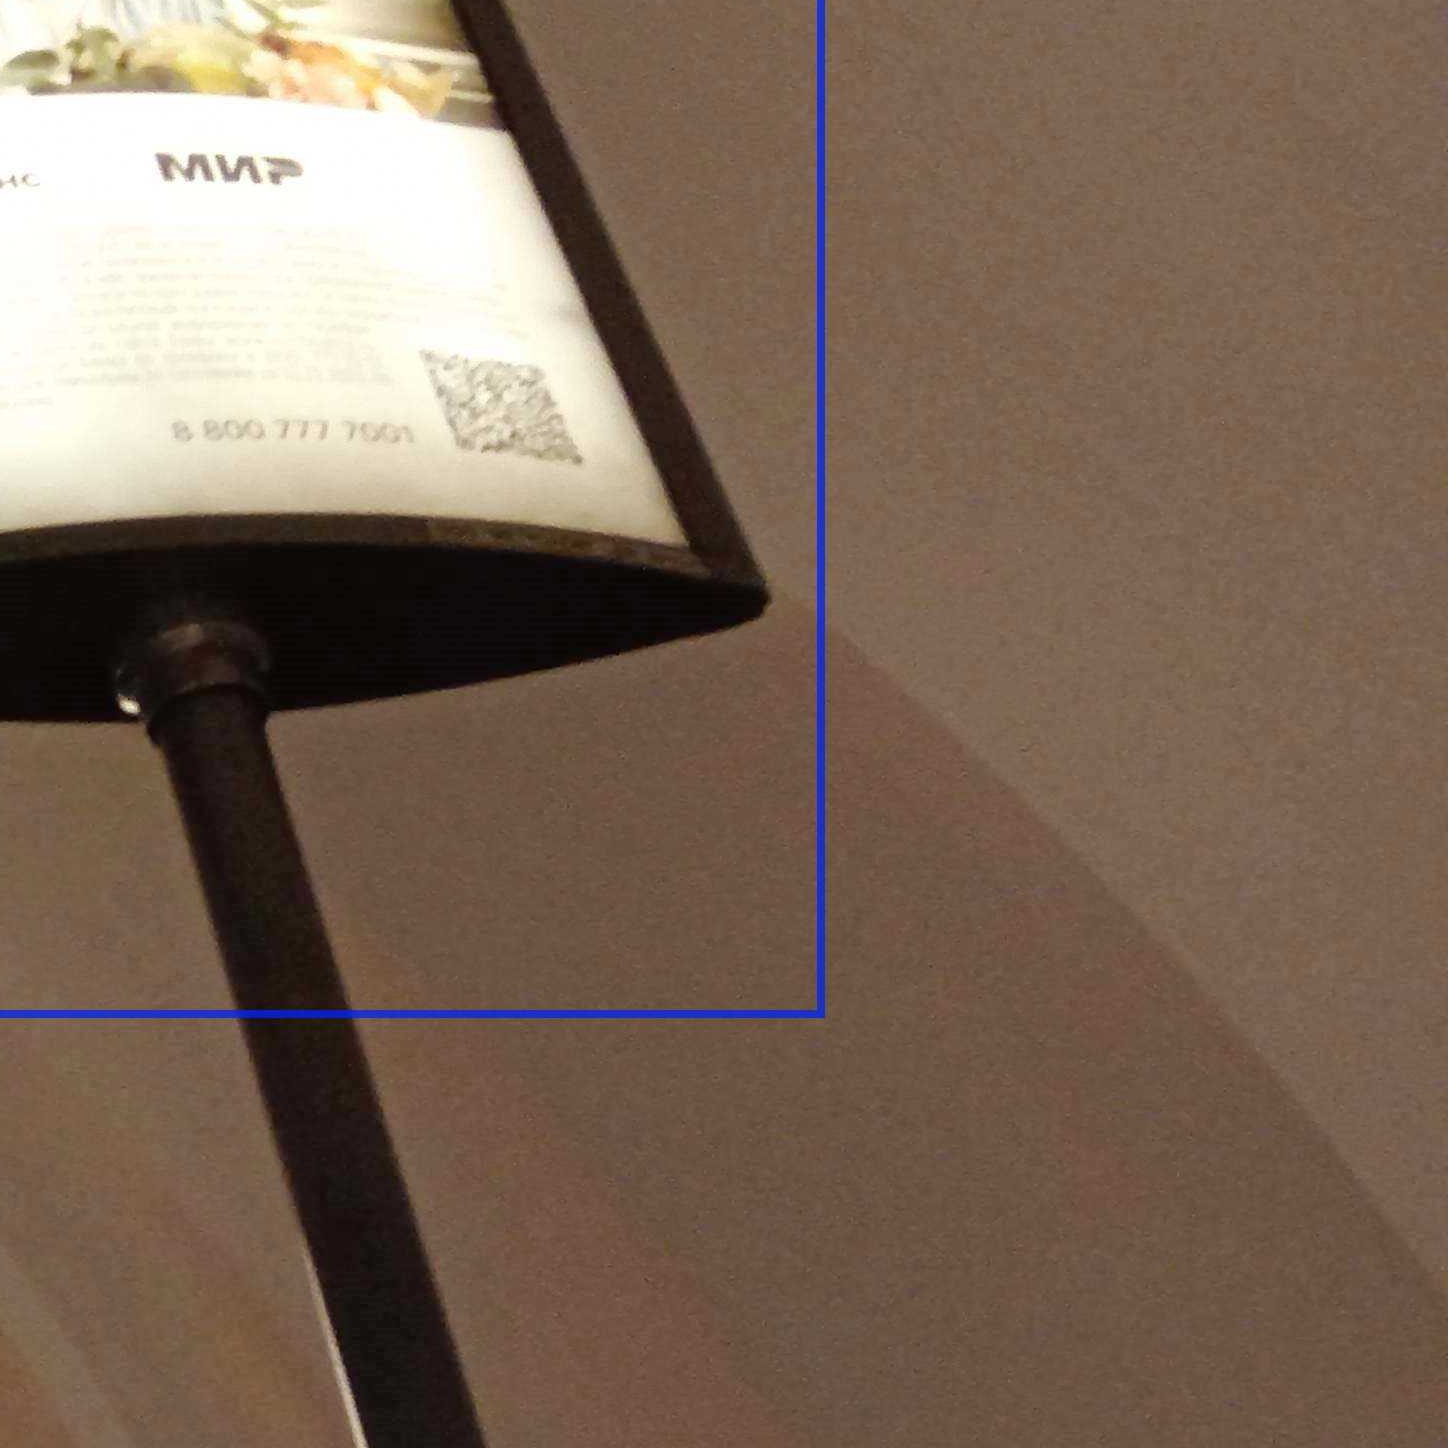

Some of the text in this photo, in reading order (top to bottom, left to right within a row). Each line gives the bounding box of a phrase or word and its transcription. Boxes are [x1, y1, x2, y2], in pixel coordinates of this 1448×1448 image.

[156, 154, 304, 186] МИР
[170, 419, 194, 443] 8
[203, 418, 266, 442] 800
[273, 418, 329, 441] 777
